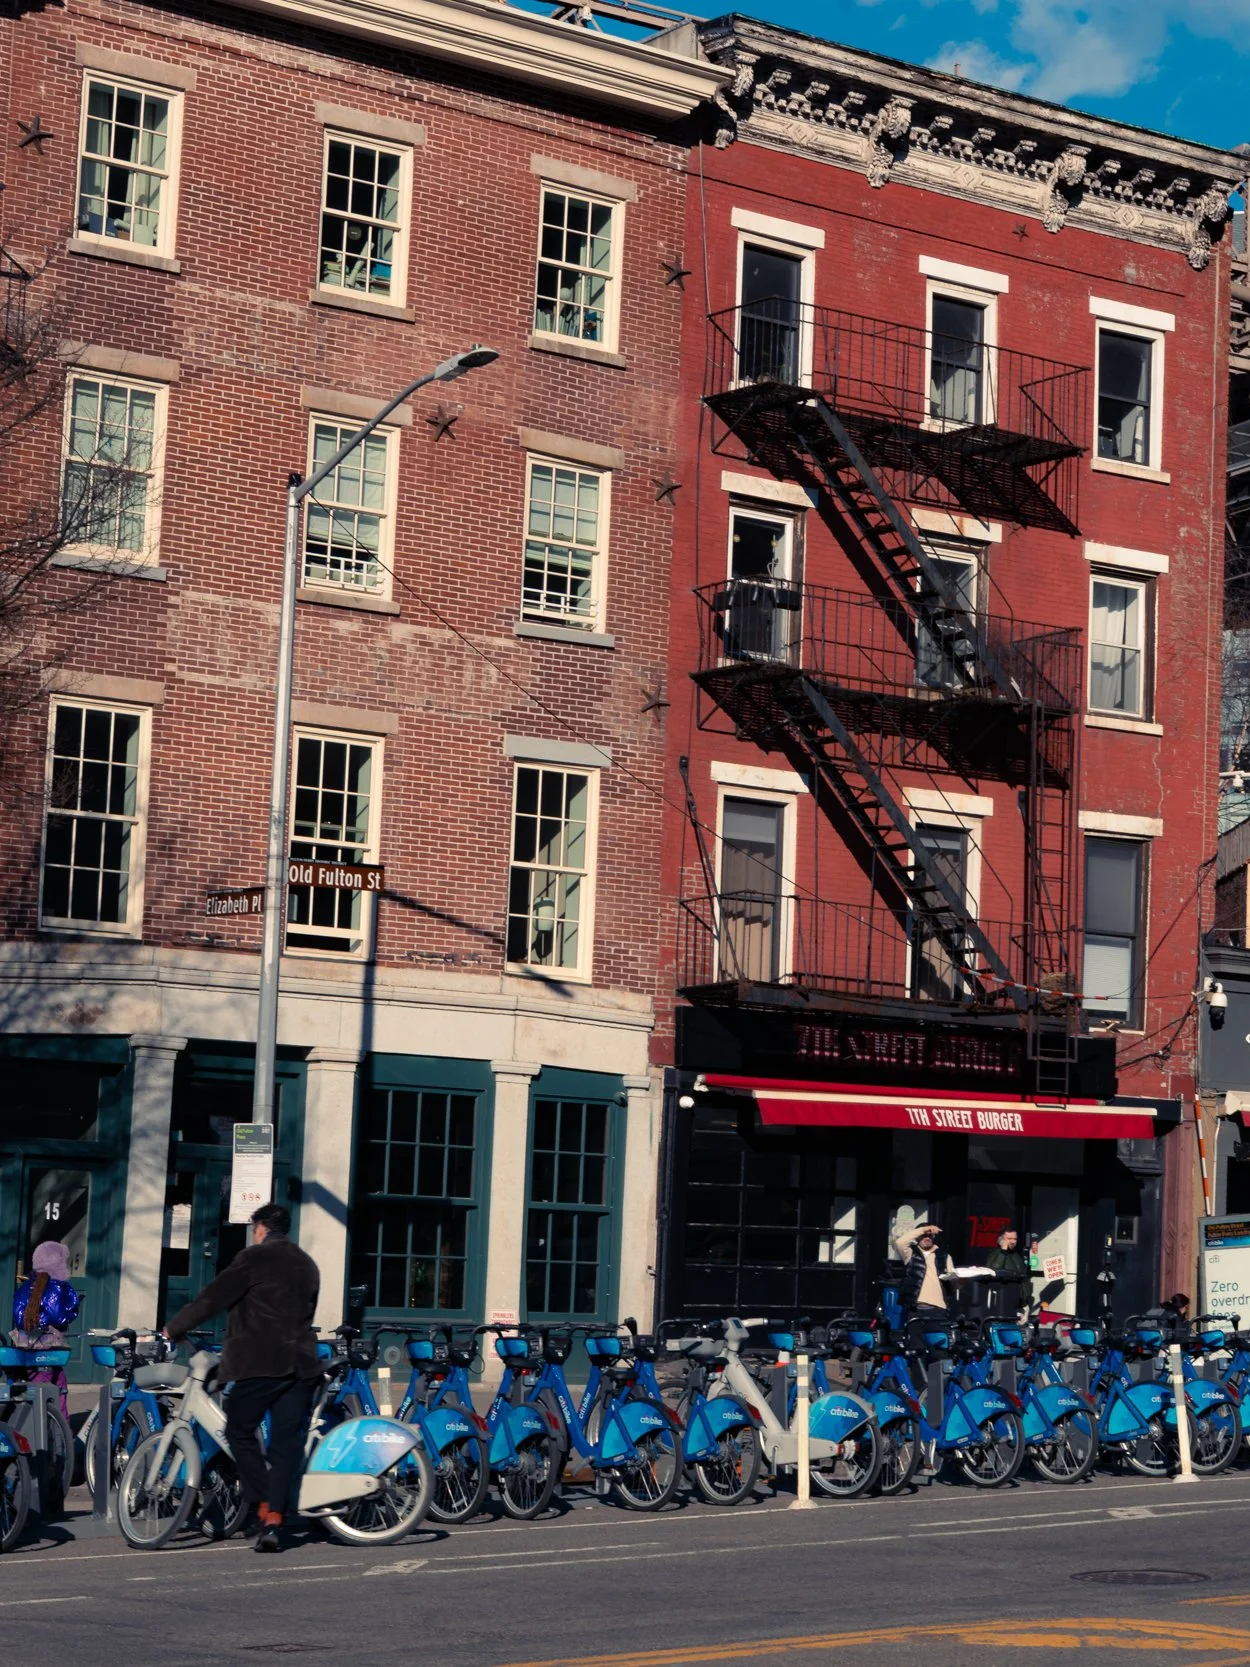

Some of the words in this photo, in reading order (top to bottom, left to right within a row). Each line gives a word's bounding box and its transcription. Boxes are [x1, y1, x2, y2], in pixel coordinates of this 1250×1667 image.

[288, 865, 313, 884] Old
[318, 867, 362, 888] Fulton
[367, 872, 381, 890] St
[206, 895, 249, 915] Elizabeth
[252, 894, 262, 913] Pl
[905, 1107, 931, 1127] 7TH
[932, 1109, 974, 1129] STREET
[976, 1111, 1024, 1132] BURGER
[44, 1201, 60, 1221] 15
[1208, 1254, 1220, 1264] citi
[1211, 1280, 1239, 1293] Zero
